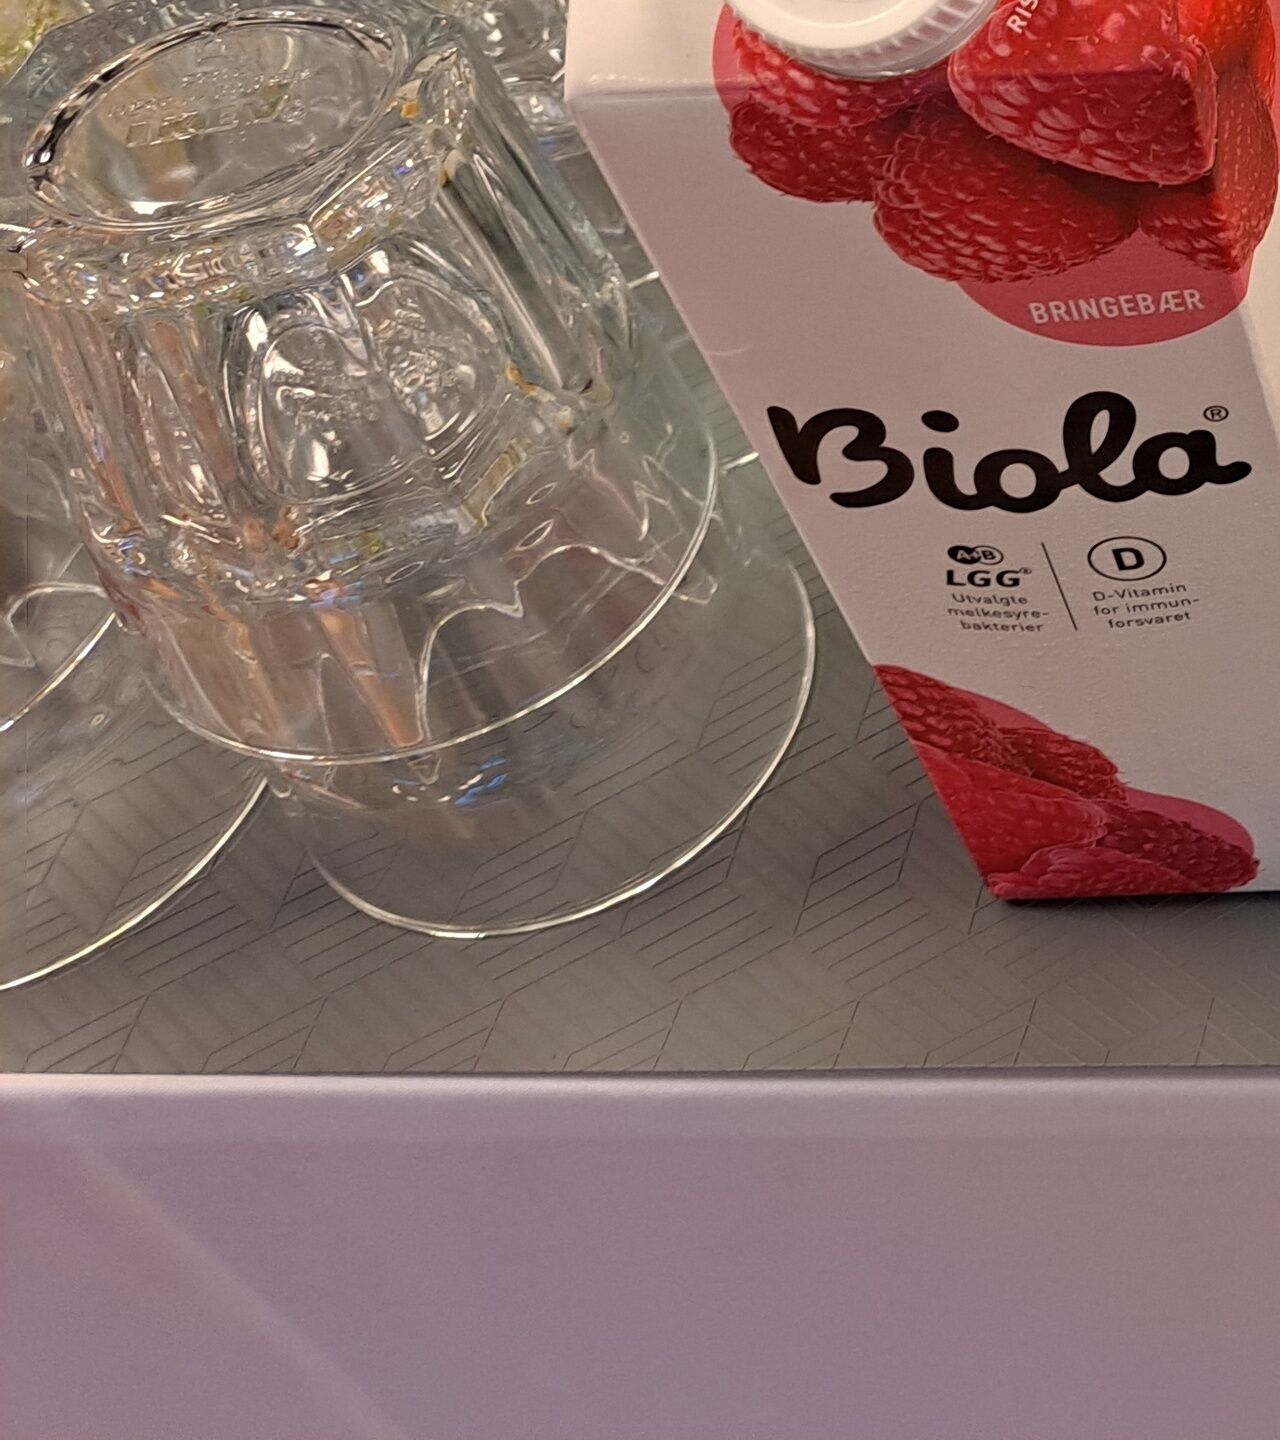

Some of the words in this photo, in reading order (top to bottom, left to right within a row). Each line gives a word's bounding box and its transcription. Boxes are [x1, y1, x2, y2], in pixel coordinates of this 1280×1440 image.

[1029, 289, 1204, 325] BRINGEBÆR
[767, 390, 1252, 513] Biola
[951, 593, 1029, 606] Utvalgte
[1092, 583, 1188, 602] D-Vitamin
[947, 608, 1050, 620] melkesyre-
[1094, 604, 1120, 616] for
[1125, 597, 1201, 613] immun-
[960, 620, 1044, 633] bakterier
[1108, 612, 1192, 629] forsvaret
